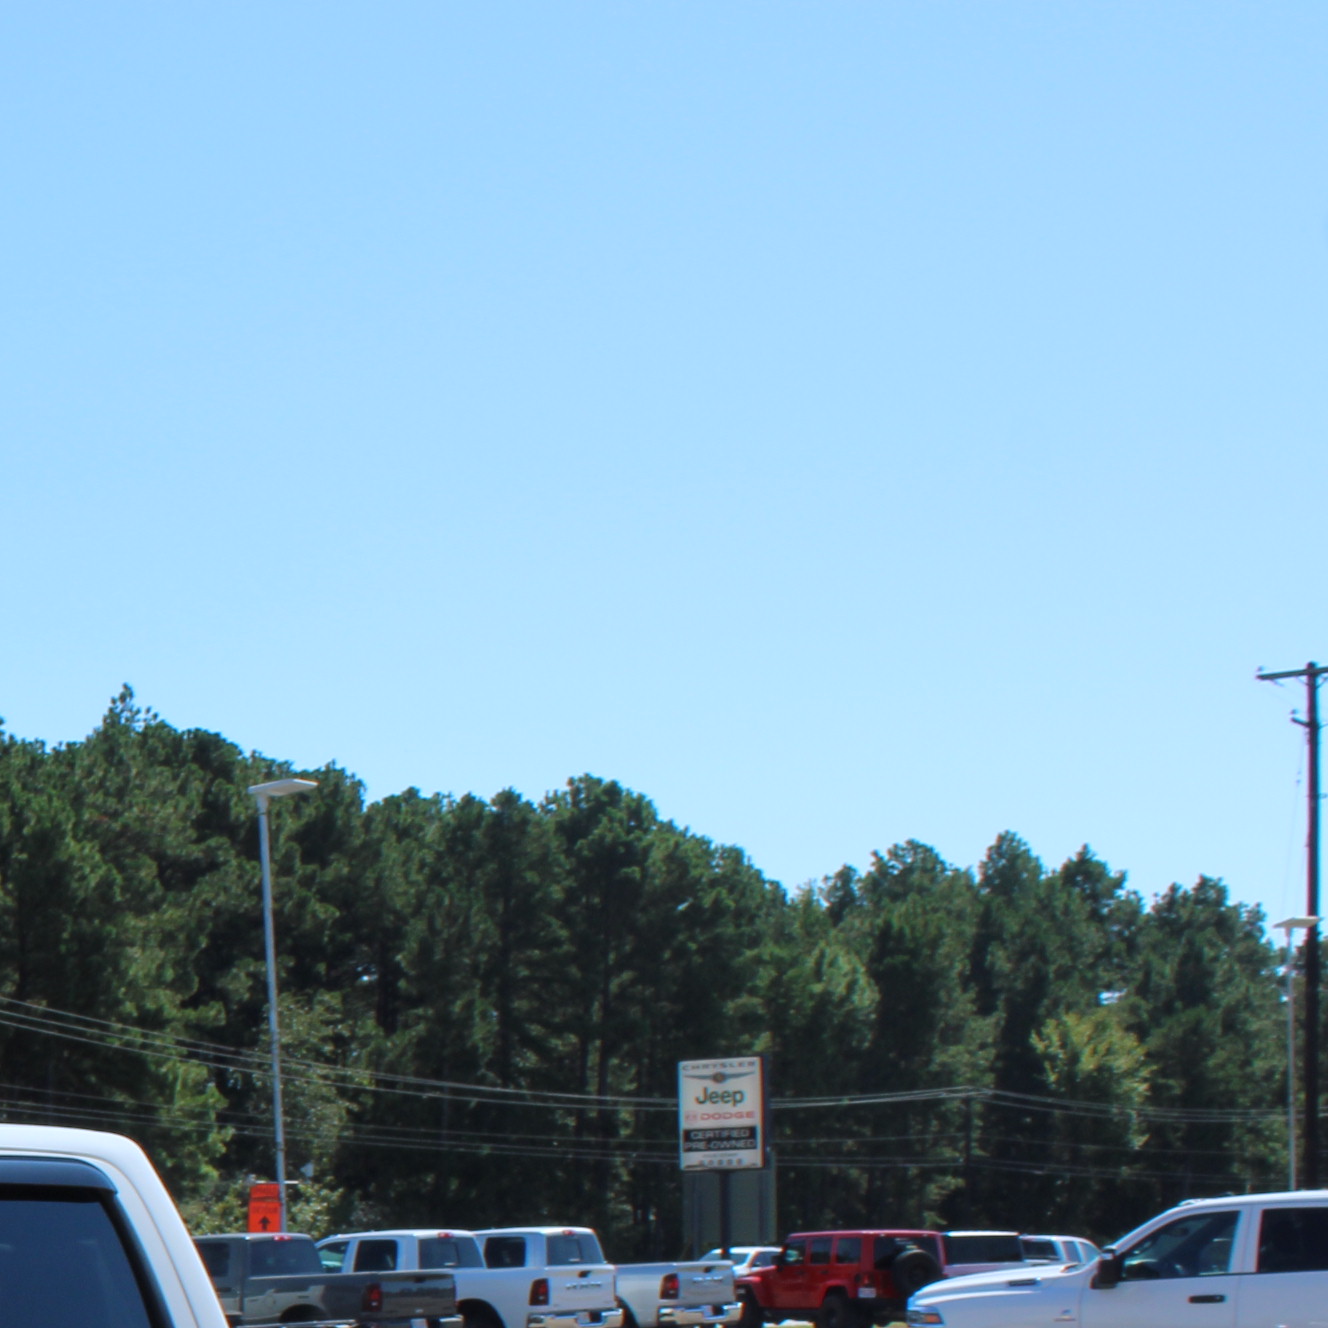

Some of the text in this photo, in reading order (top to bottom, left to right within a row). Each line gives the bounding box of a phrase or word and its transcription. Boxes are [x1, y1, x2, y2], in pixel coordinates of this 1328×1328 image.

[682, 1061, 756, 1070] CHRYSLER
[694, 1087, 744, 1107] Jeep
[700, 1111, 754, 1120] DODGE
[690, 1130, 749, 1139] CERTIFIED
[684, 1139, 756, 1150] PRE-OWNED
